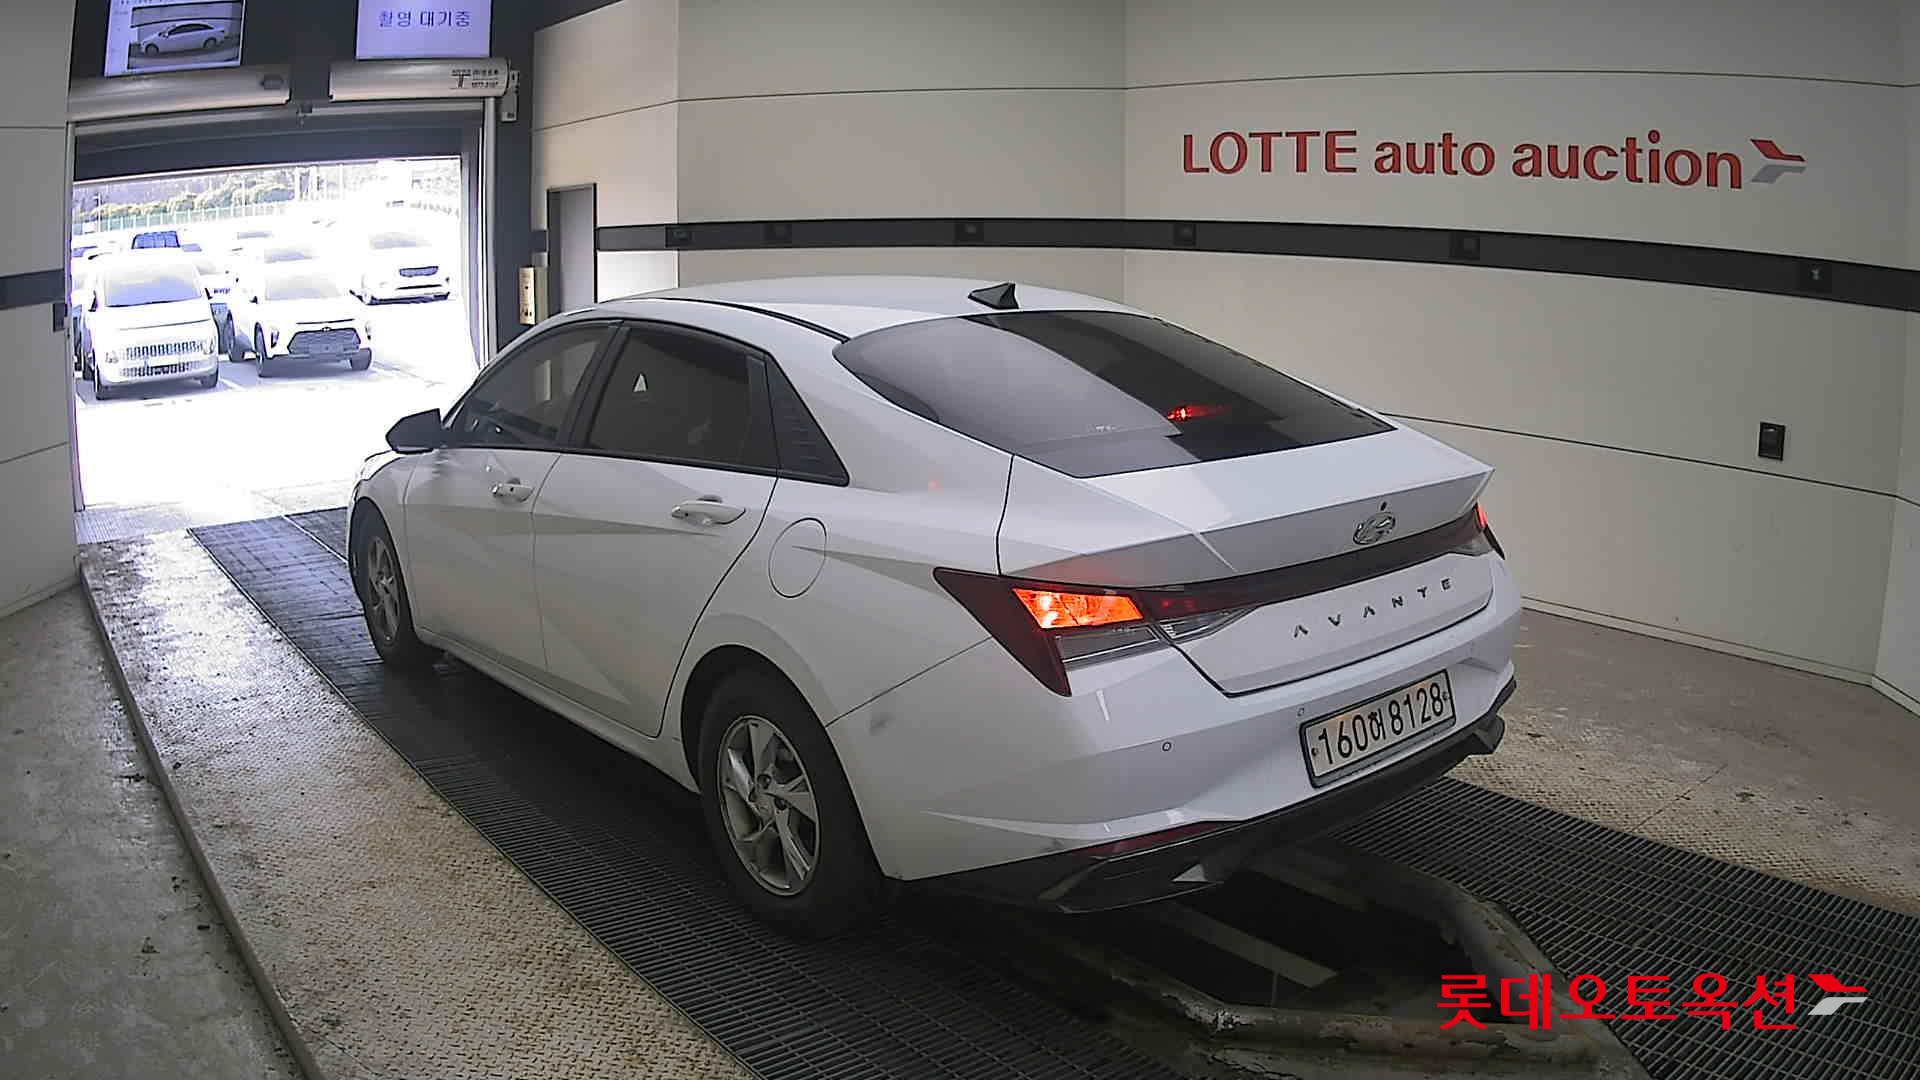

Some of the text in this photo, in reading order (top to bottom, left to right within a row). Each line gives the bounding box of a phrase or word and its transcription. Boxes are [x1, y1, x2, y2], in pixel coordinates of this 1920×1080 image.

[420, 10, 471, 28] 대기중
[1183, 129, 1743, 189] LOTTE auto auction
[1292, 577, 1453, 639] AVANTE
[1318, 682, 1444, 765] 160허8128
